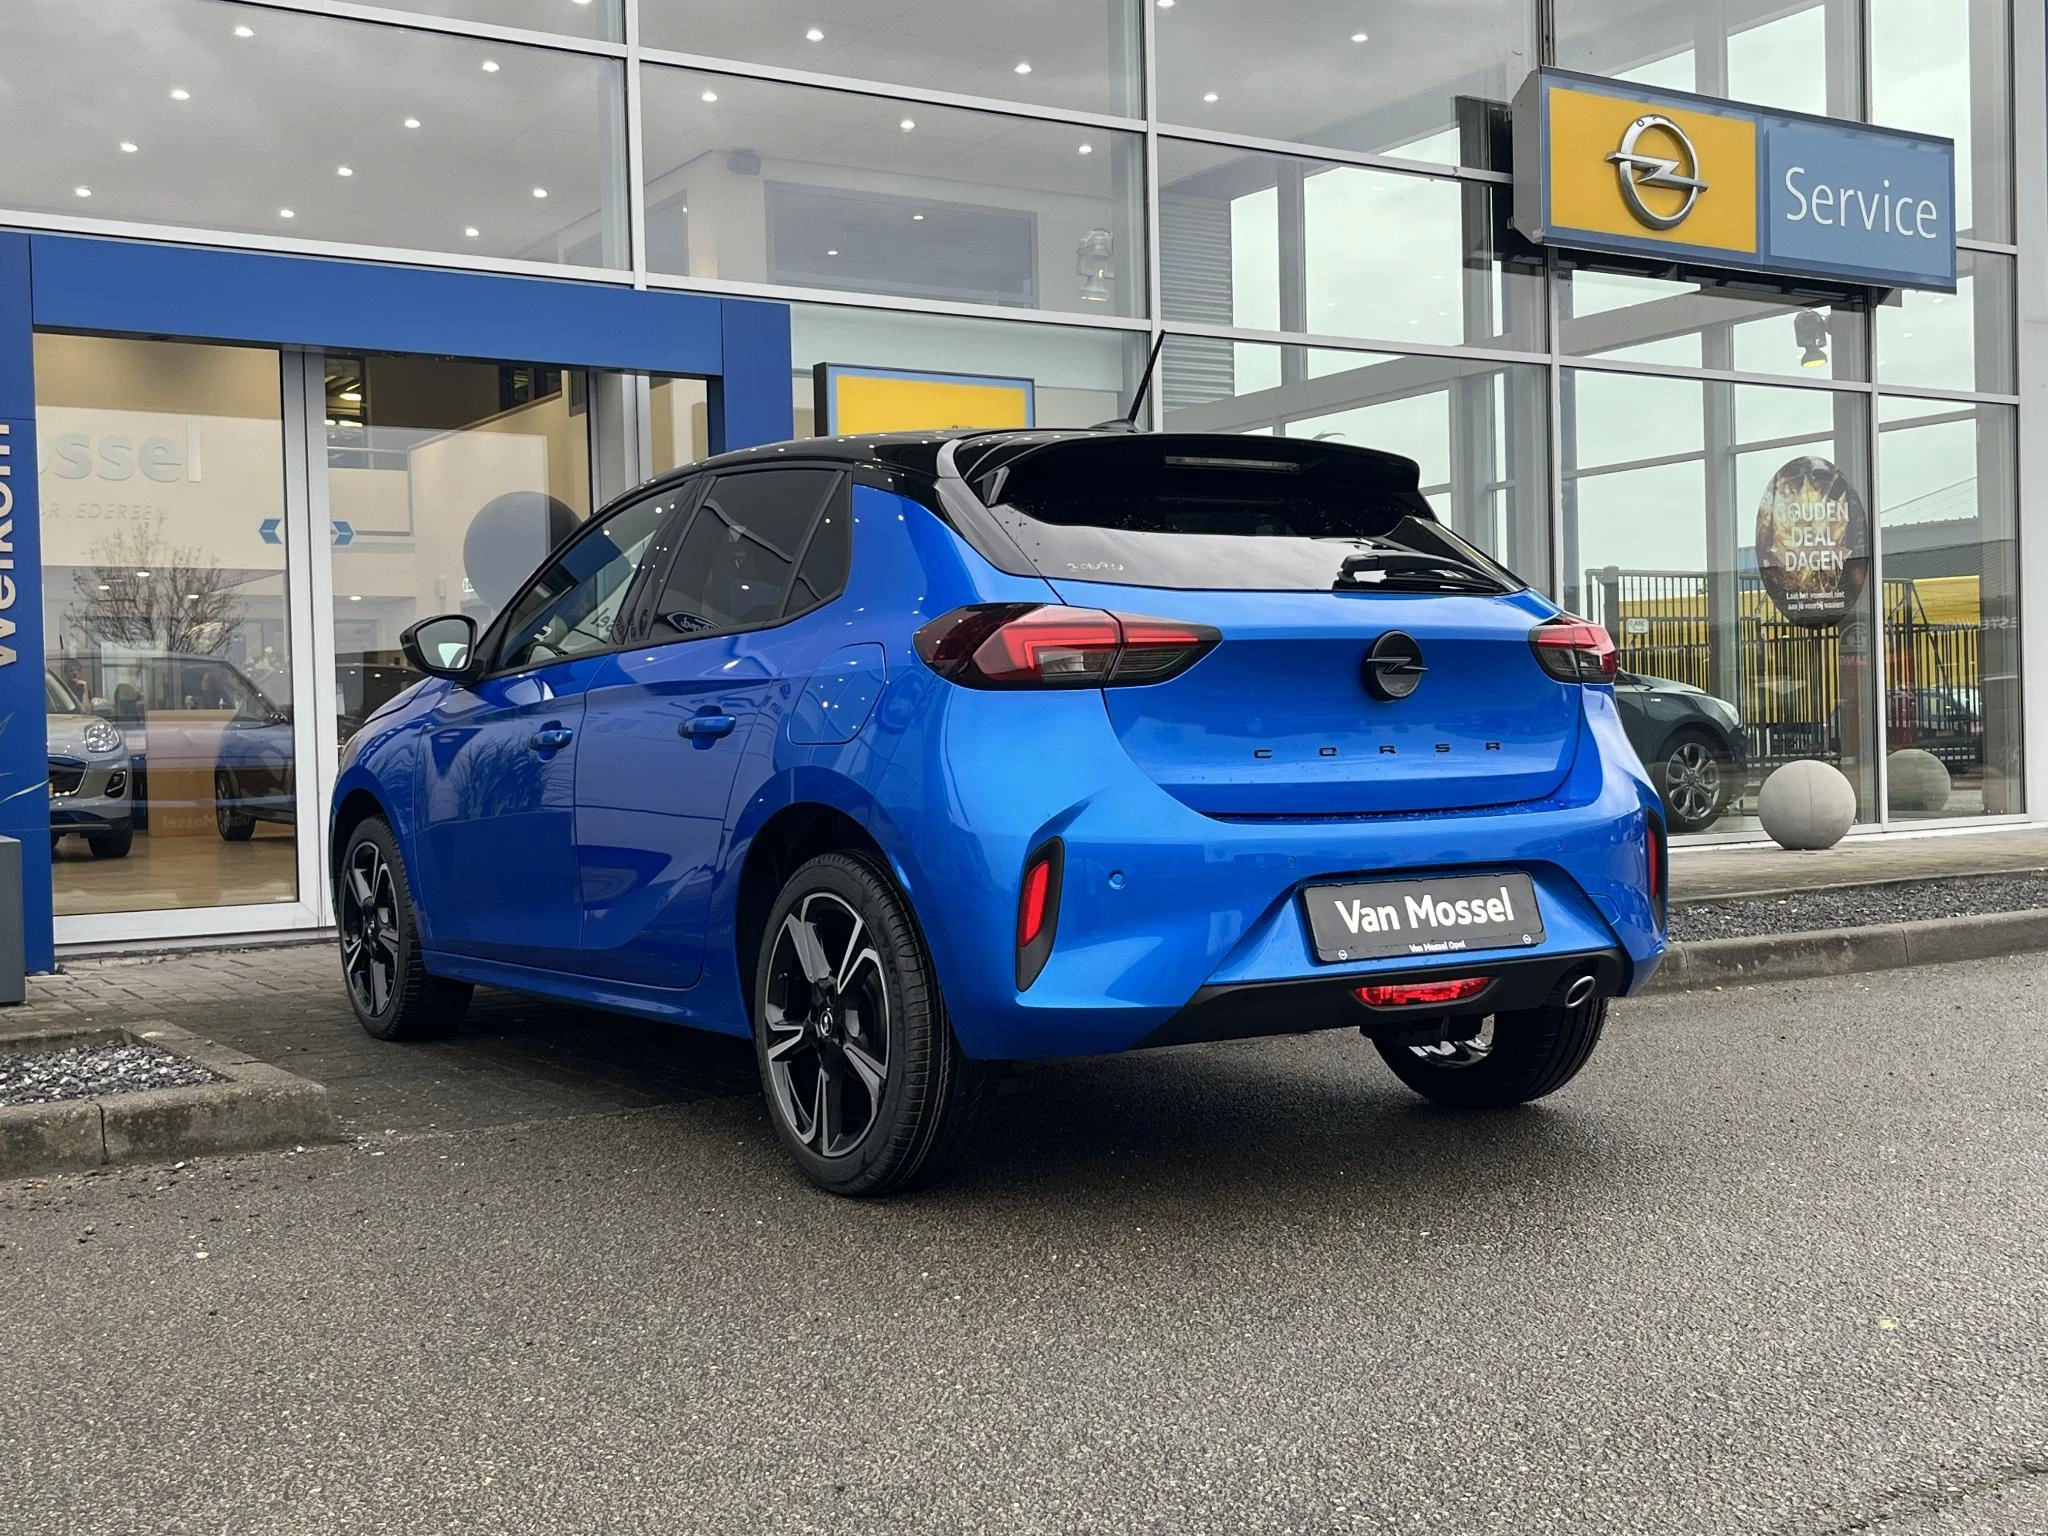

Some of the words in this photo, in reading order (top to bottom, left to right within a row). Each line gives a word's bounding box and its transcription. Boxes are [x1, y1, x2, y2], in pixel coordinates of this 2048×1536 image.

[1785, 166, 1937, 239] Service
[39, 419, 202, 483] ssel
[1774, 501, 1849, 522] GOUDEN
[1791, 526, 1836, 547] DEAL
[1785, 550, 1844, 572] DAGEN
[1334, 899, 1400, 934] Van
[1404, 886, 1515, 929] Mossel
[1409, 943, 1423, 953] Van
[1423, 941, 1448, 952] Mossel
[1448, 940, 1466, 950] Opel
